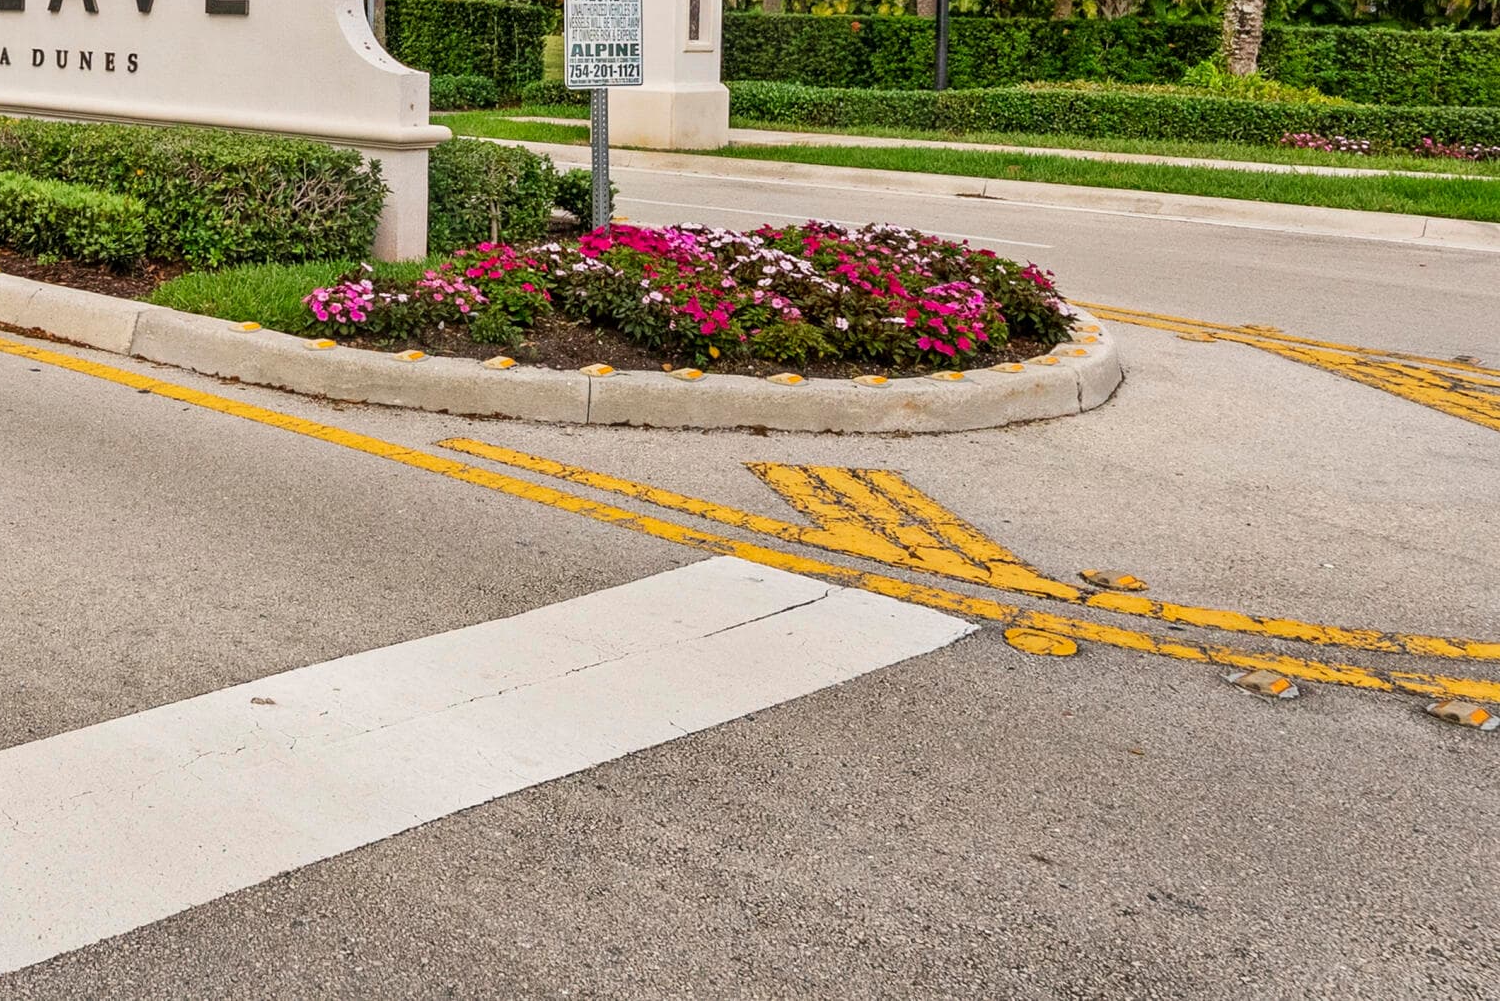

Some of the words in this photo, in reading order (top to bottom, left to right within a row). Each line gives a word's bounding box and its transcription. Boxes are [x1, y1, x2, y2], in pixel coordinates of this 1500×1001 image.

[570, 43, 640, 57] ALPINE
[31, 48, 139, 73] DUNES
[569, 64, 640, 78] 754-201-1121
